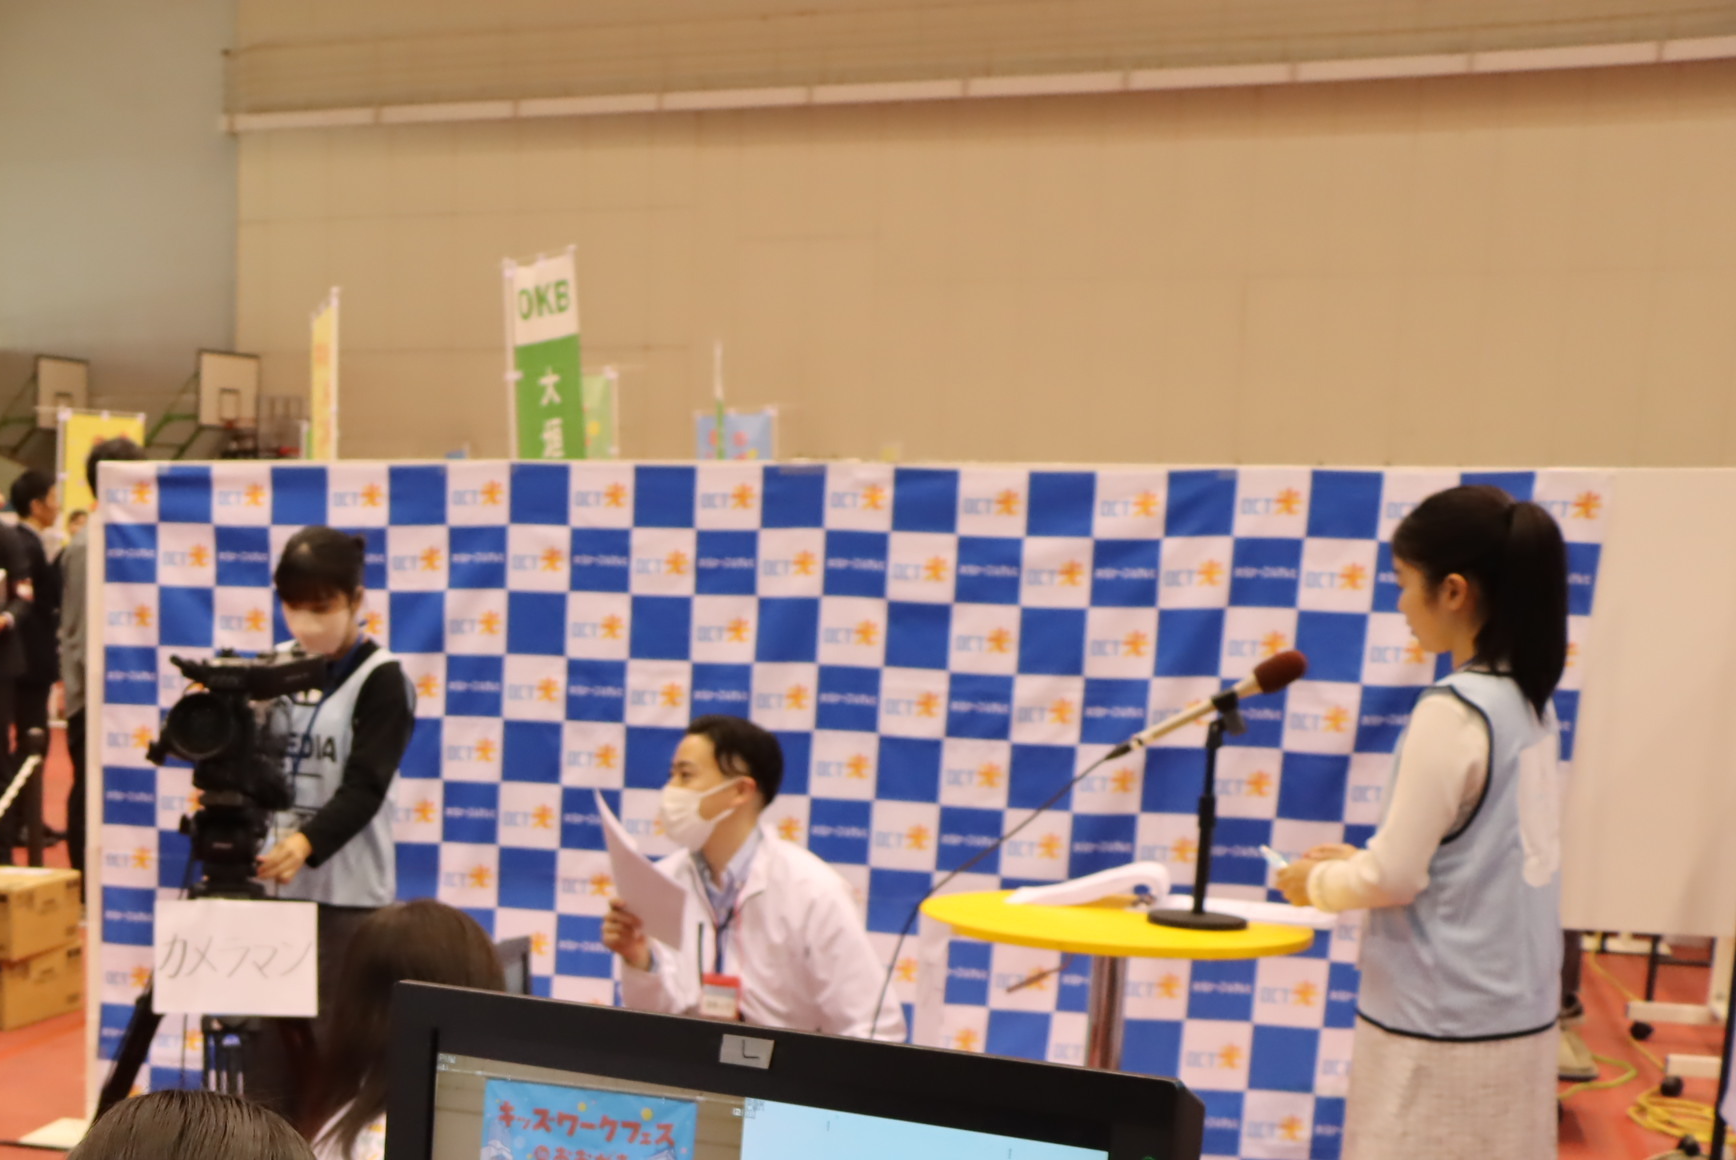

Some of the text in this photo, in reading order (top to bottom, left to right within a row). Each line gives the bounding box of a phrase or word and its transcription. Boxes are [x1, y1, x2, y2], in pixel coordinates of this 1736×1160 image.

[518, 280, 571, 320] OKB
[159, 933, 312, 979] カメラマン
[498, 1100, 675, 1146] キッズワークフェス
